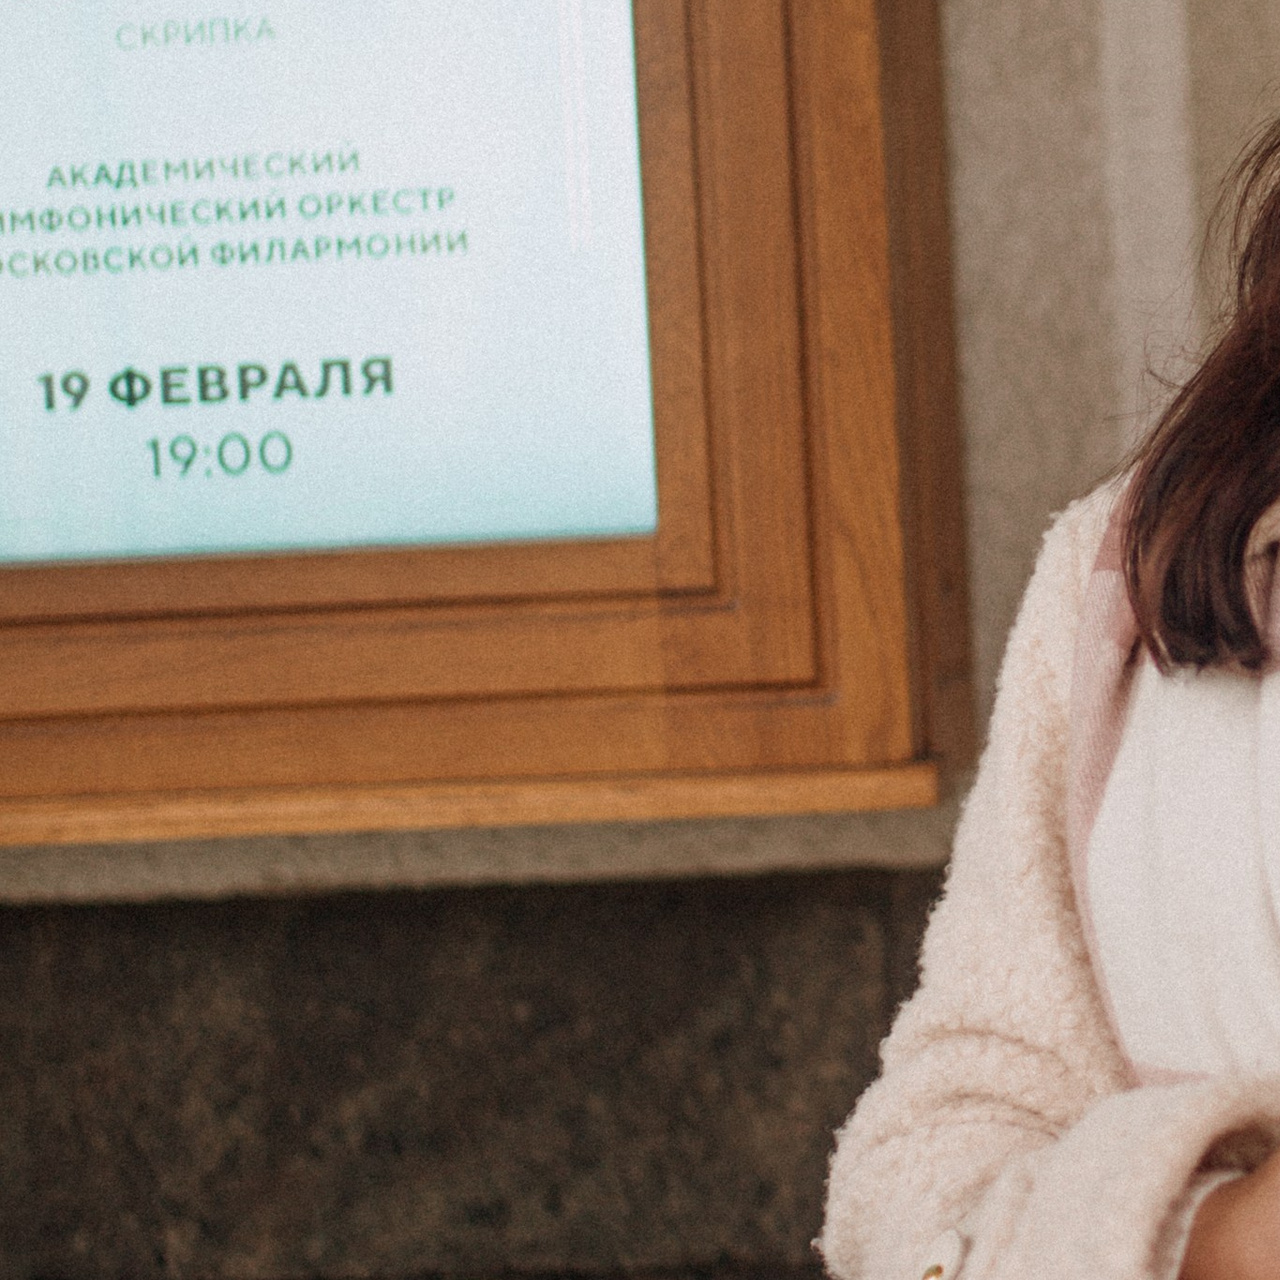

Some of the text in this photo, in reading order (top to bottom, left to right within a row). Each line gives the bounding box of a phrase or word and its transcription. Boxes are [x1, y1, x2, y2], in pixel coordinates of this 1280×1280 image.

[116, 18, 276, 51] СКРИПКА
[47, 140, 360, 189] АКАДЕМИЧЕСКИЙ
[0, 187, 455, 235] МФОНИЧЕСКИЙ ОРКЕСТР
[0, 229, 469, 279] СКОВСКОЙ ФИЛАРМОНИИ
[37, 357, 394, 411] 19 ФЕВРАЛЯ
[147, 431, 294, 478] 19:00
